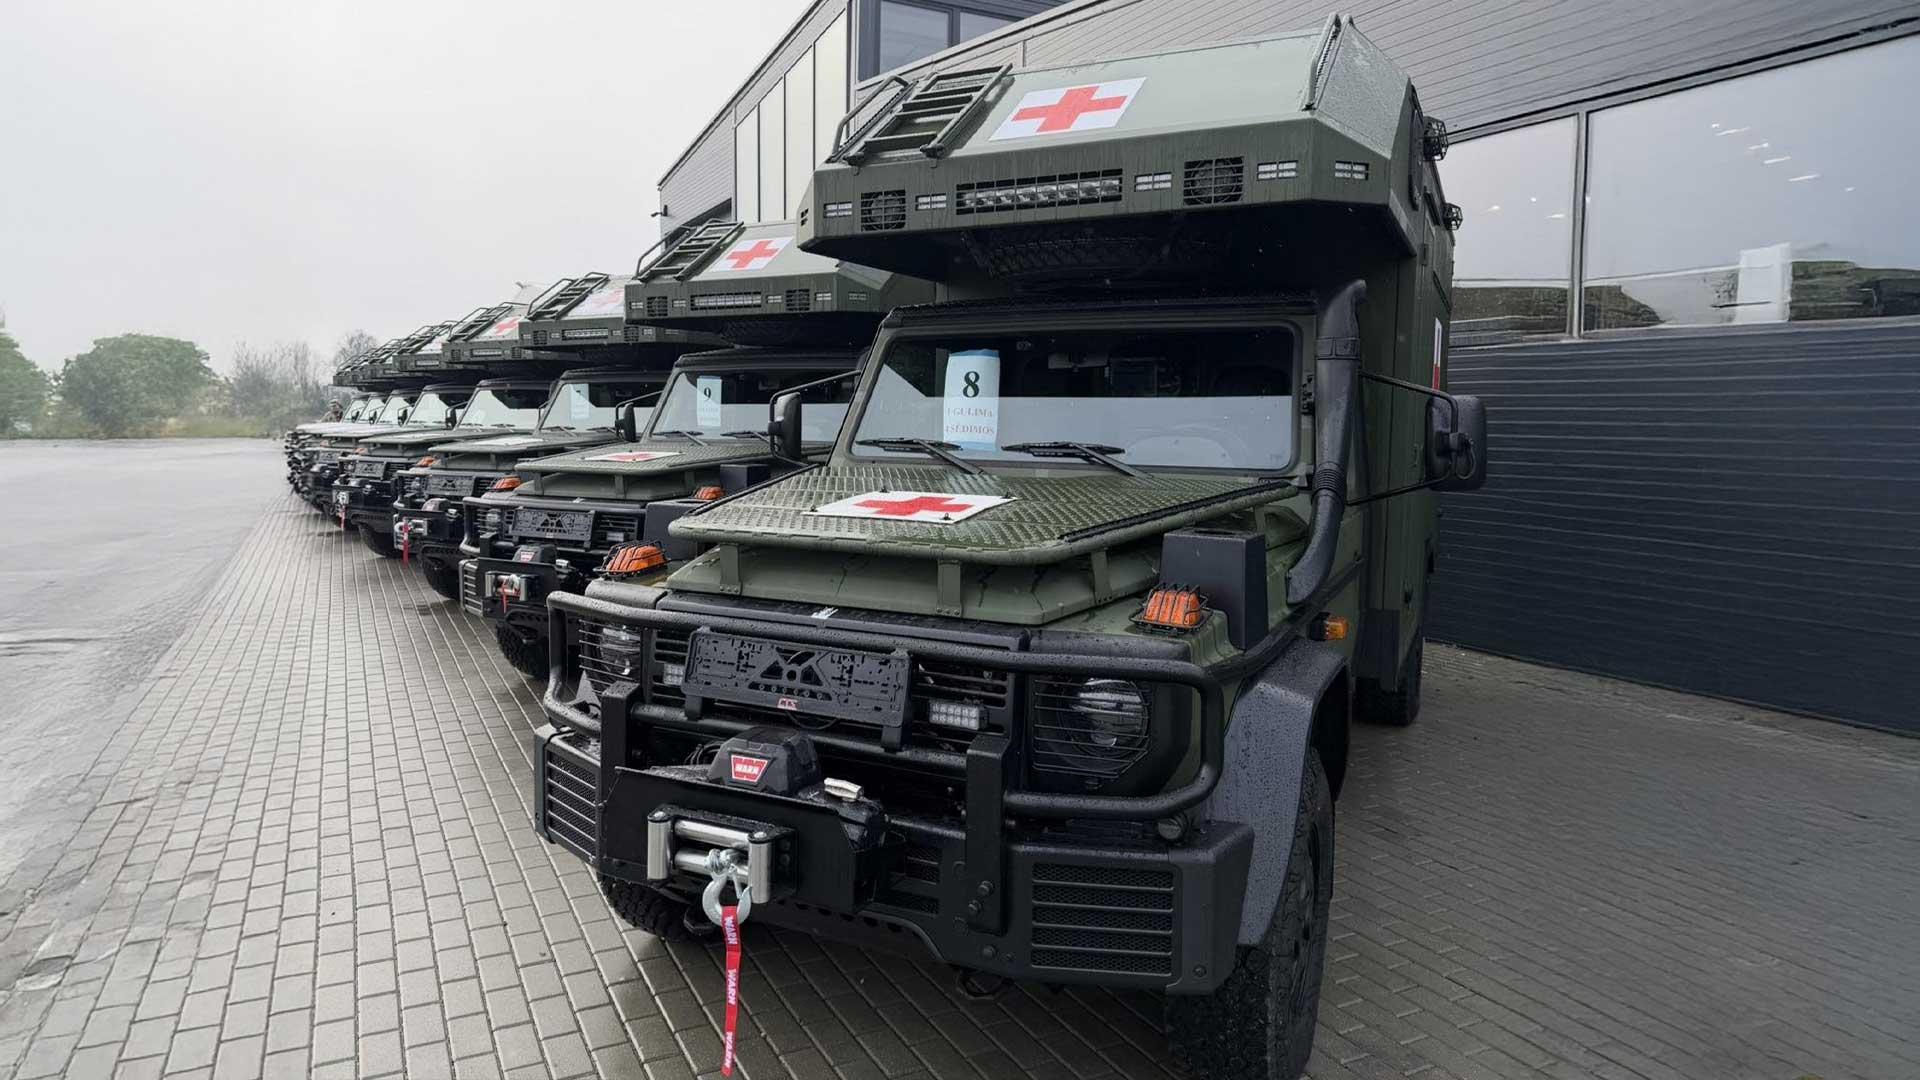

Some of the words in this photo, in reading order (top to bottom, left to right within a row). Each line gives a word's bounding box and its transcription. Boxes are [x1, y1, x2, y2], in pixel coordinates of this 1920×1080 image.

[703, 386, 712, 401] 9
[962, 370, 980, 398] 8
[724, 915, 738, 945] WARN
[727, 968, 737, 1006] WARN
